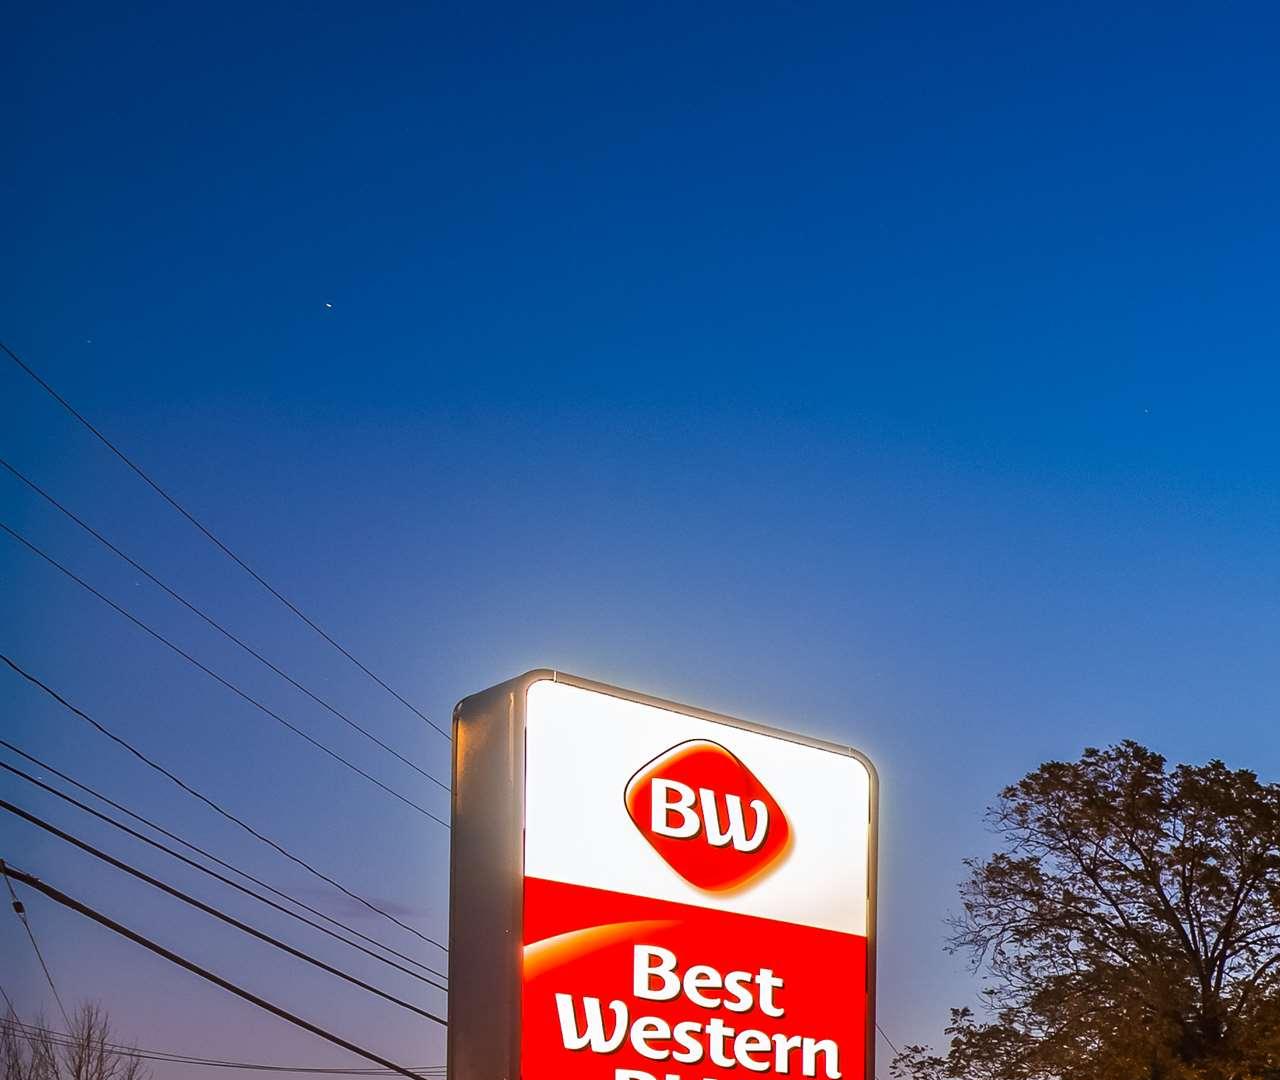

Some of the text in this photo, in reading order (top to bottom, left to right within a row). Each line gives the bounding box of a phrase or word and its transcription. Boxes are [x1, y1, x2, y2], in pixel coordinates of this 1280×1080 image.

[651, 777, 769, 852] BW
[633, 944, 784, 1017] Best
[555, 993, 842, 1080] Western
